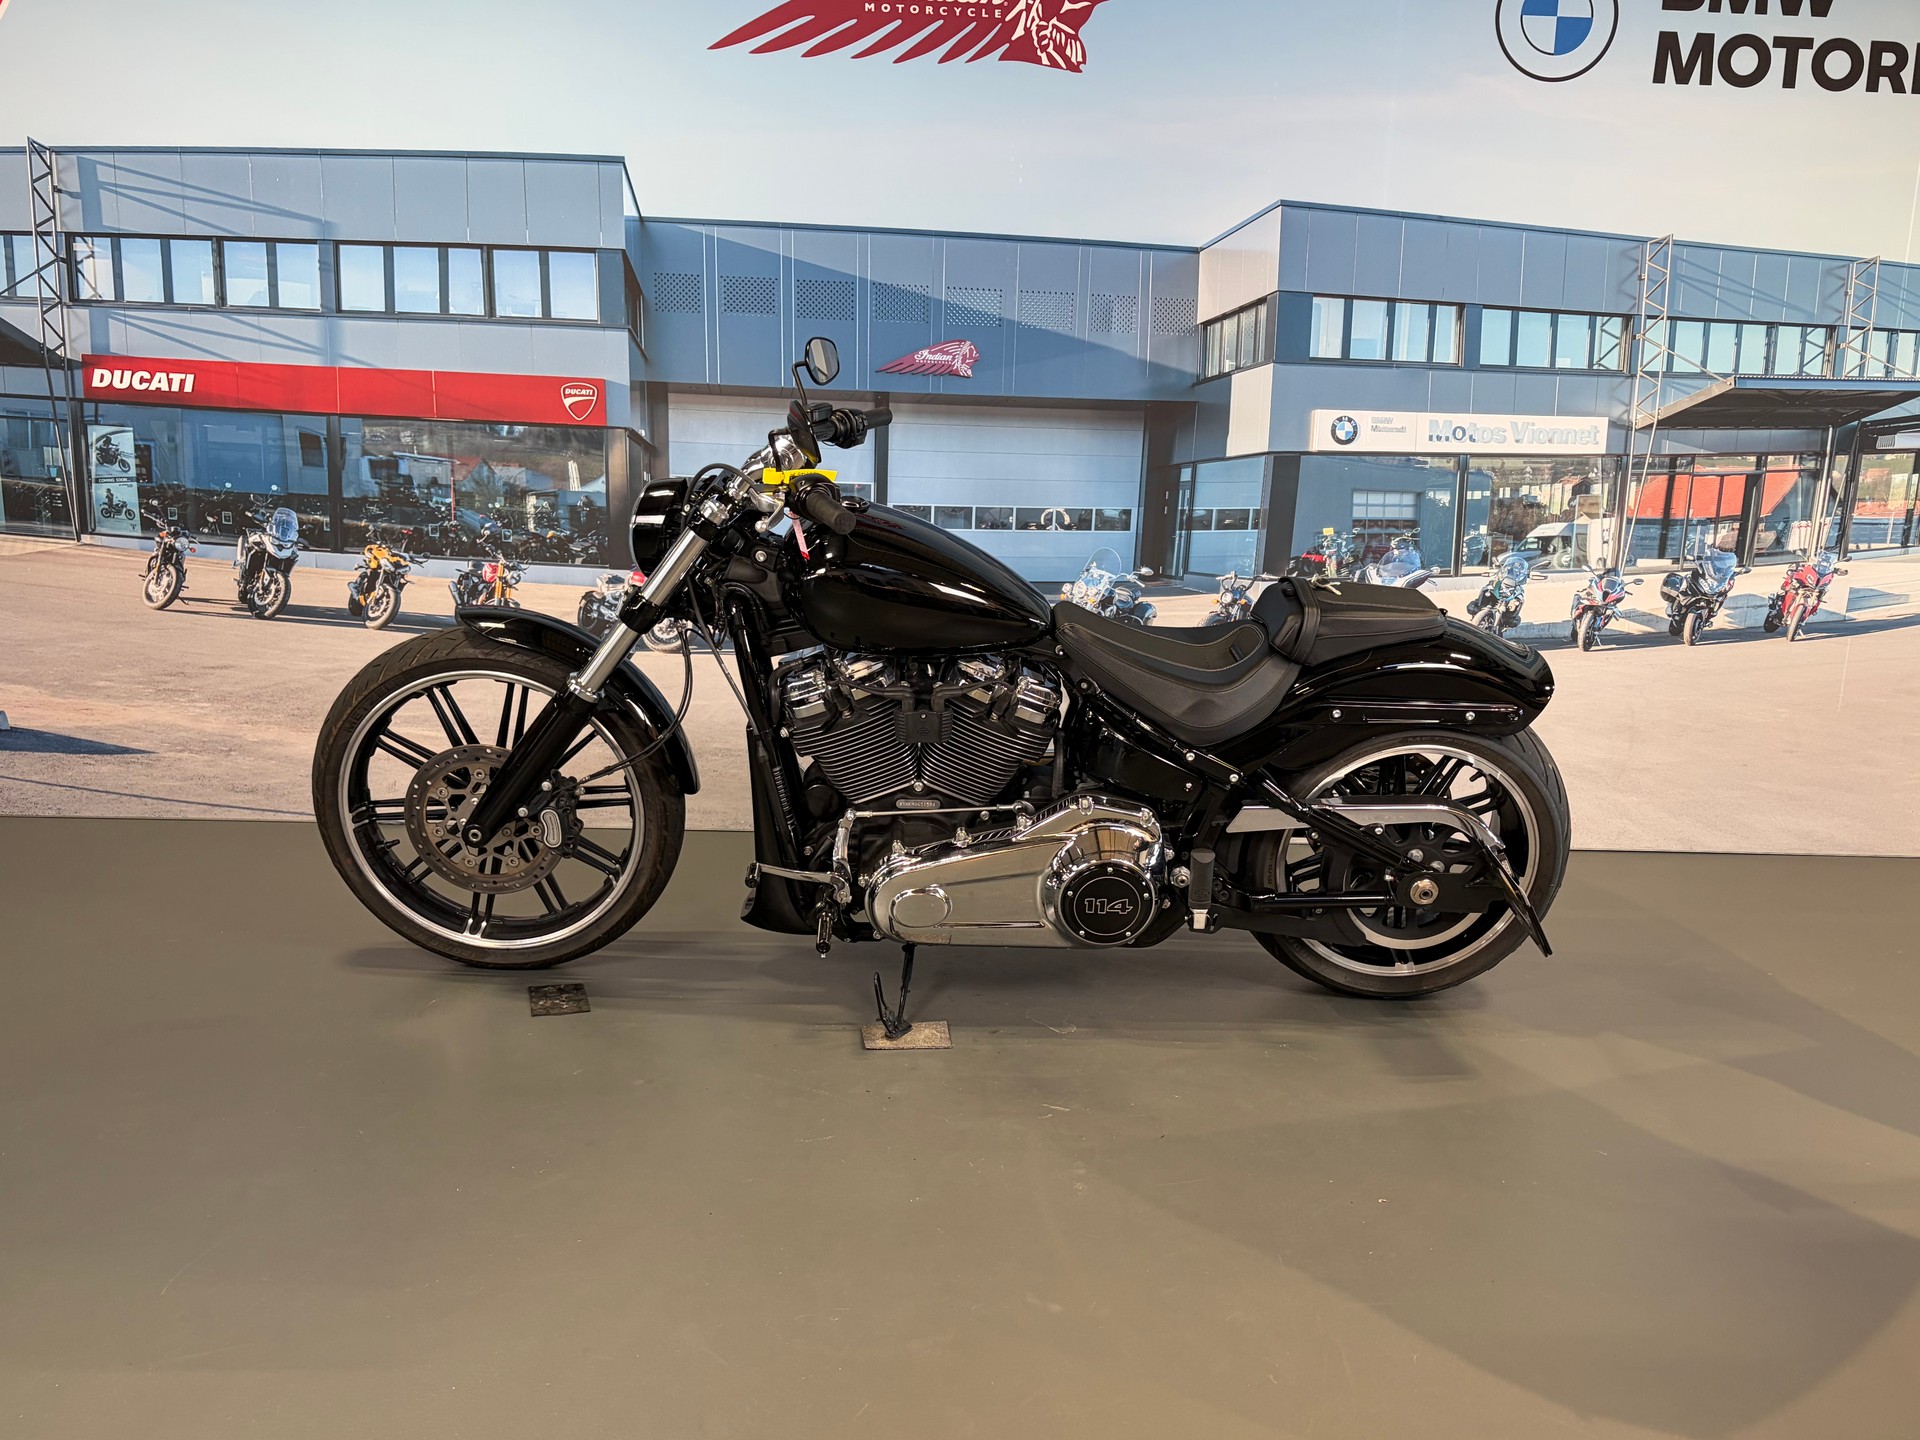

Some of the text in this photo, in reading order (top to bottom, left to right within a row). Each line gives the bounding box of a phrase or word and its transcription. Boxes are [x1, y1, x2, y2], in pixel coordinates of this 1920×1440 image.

[864, 2, 1002, 18] MOTORCYCLE
[1652, 30, 1920, 95] MOTOR
[914, 349, 953, 361] Indian
[91, 368, 195, 393] DUCATI
[565, 388, 593, 396] DUCATI
[1428, 419, 1600, 446] Motos Vionnet
[1084, 897, 1134, 915] 114
